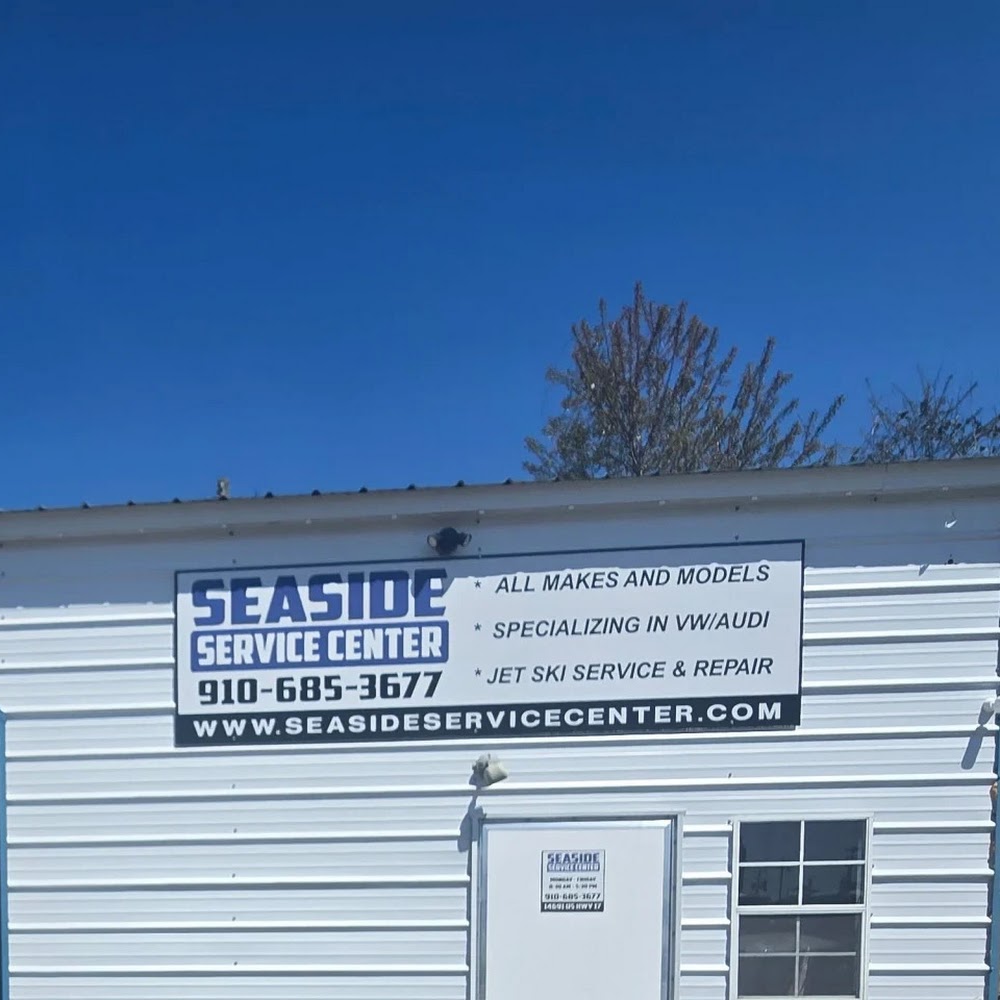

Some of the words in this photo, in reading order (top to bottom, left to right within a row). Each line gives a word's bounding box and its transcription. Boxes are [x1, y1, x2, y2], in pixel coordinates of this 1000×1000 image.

[495, 575, 535, 594] ALL
[542, 571, 618, 591] MAKES
[623, 568, 671, 587] AND
[677, 564, 770, 585] MODELS
[191, 568, 448, 627] SEASIDE
[492, 616, 640, 639] SPECIALIZING
[646, 615, 668, 633] IN
[676, 611, 770, 631] VW/AUDI
[197, 630, 321, 666] SERVICE
[327, 626, 443, 662] CENTER
[487, 667, 526, 685] JET
[531, 664, 566, 683] SKI
[572, 661, 666, 681] SERVICE
[673, 660, 686, 677] &
[693, 657, 773, 677] REPAIR
[199, 671, 443, 705] 910-685-3677
[193, 702, 782, 738] WWW.SEASIDESERVICECENTER.COM
[547, 852, 600, 864] SEASIDE
